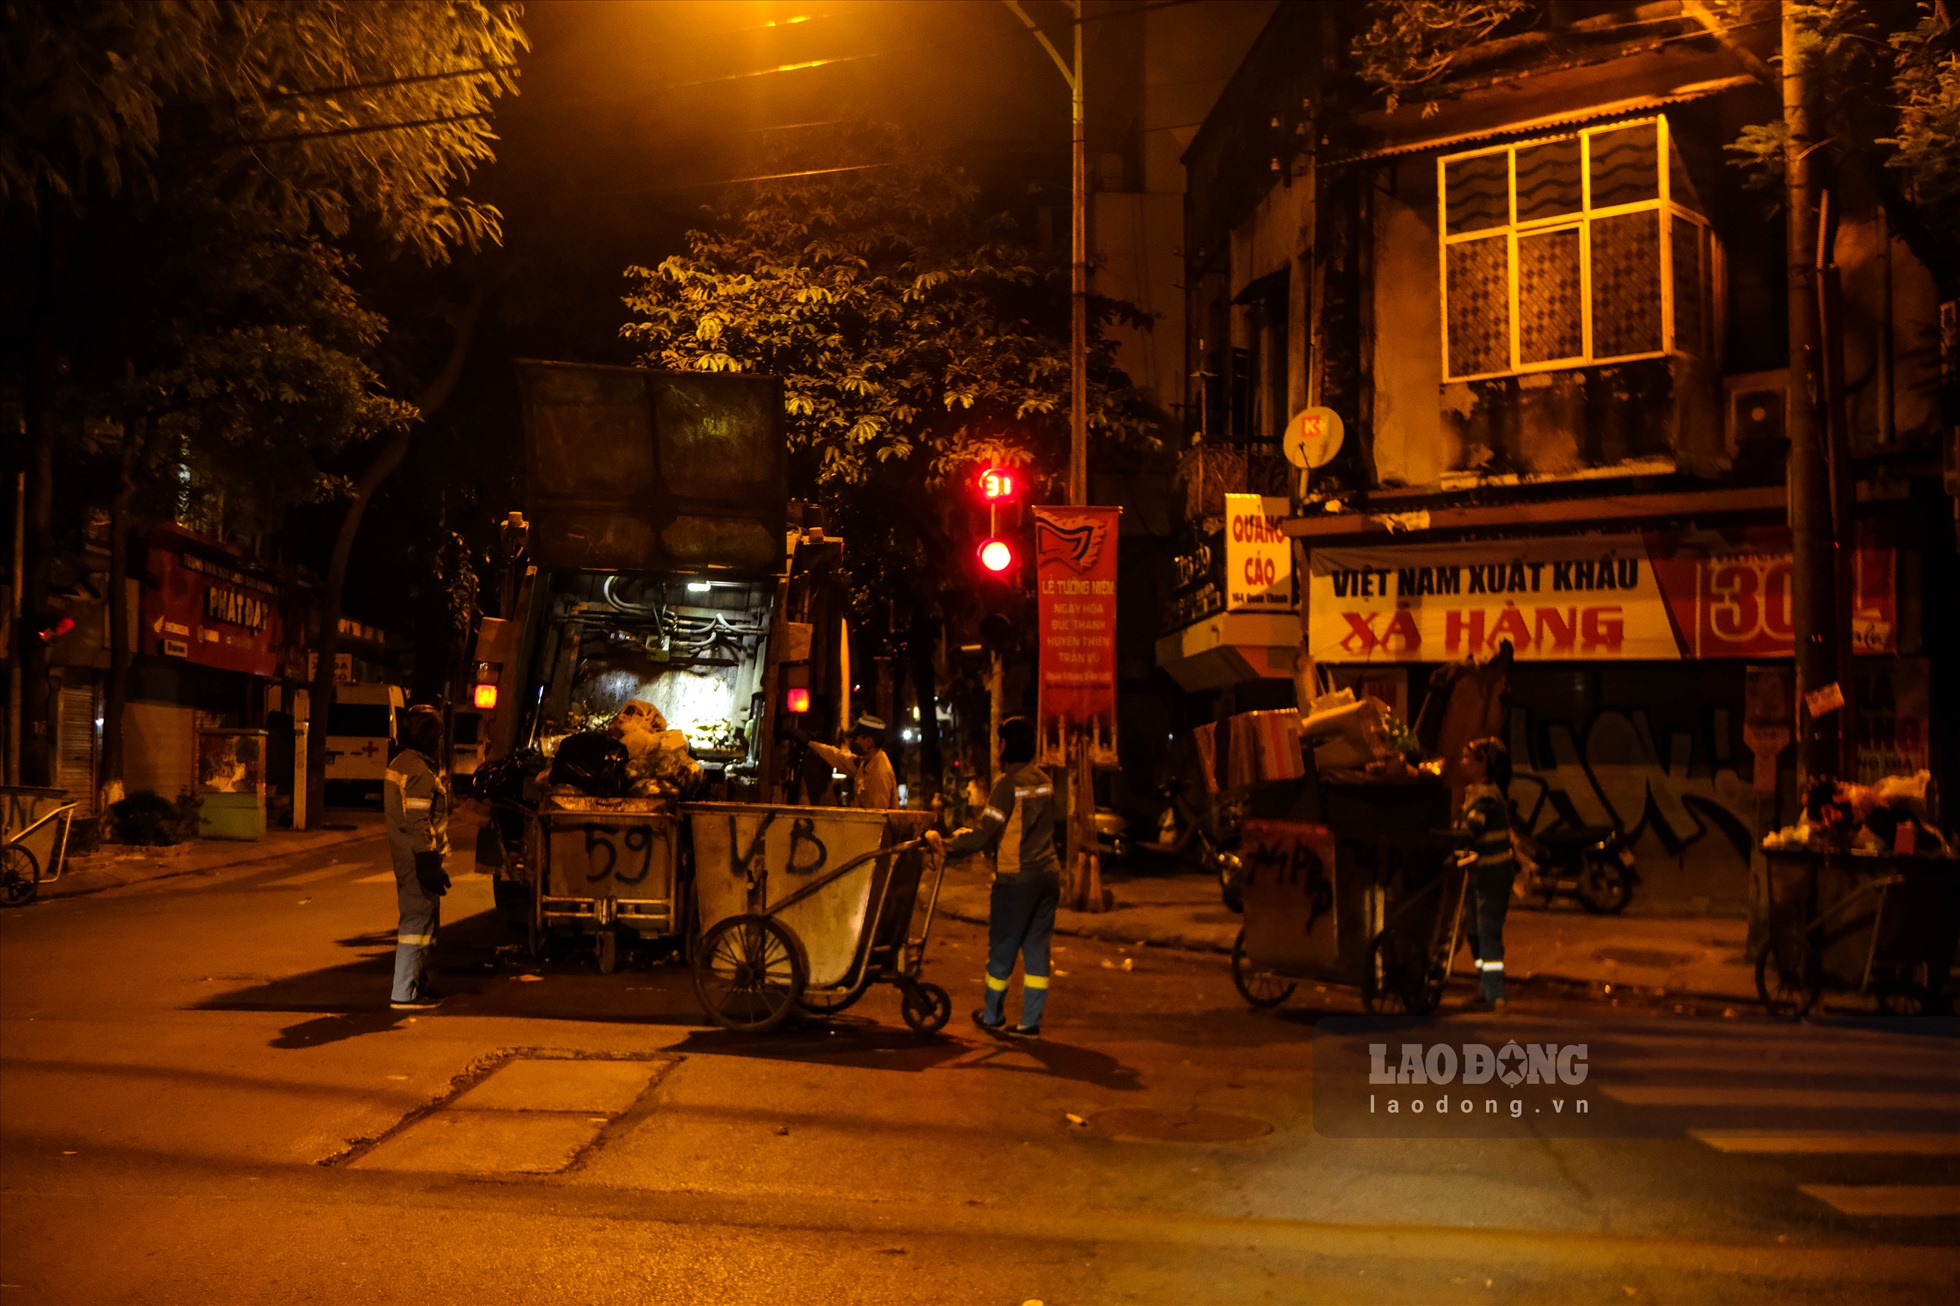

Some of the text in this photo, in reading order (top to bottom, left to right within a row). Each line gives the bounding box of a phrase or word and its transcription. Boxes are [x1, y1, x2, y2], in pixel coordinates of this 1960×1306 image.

[986, 475, 1011, 497] 31
[1244, 549, 1275, 586] CÁO
[1332, 548, 1638, 602] VIỆT NAM XUẤT KHẨU
[1445, 600, 1624, 654] HÀNG
[584, 824, 652, 885] 59
